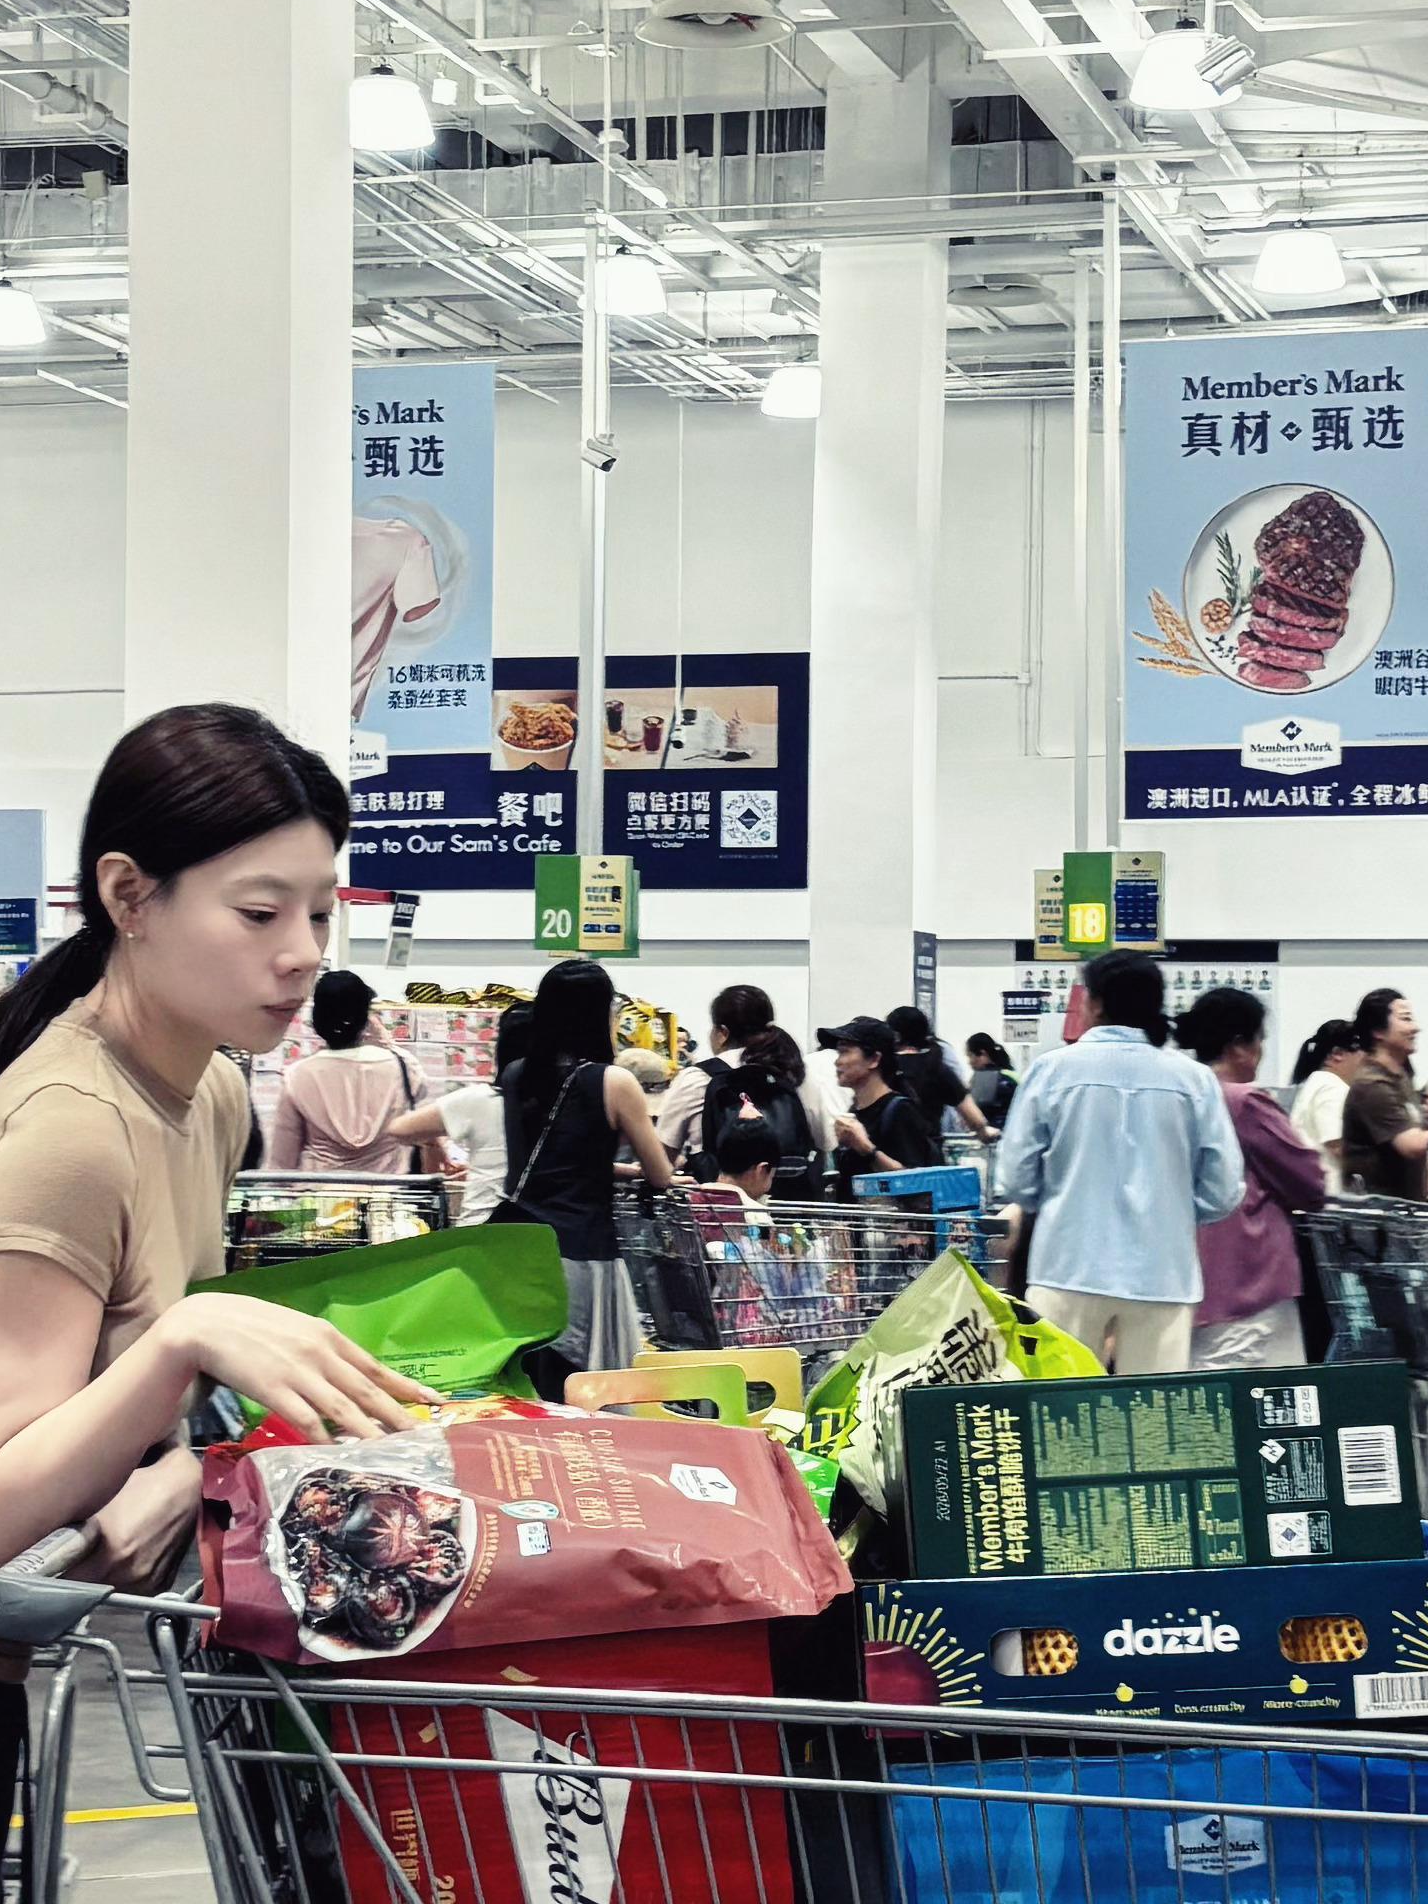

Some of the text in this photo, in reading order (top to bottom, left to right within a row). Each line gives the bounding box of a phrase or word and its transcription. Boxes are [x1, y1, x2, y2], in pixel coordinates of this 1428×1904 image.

[1182, 367, 1405, 402] Member's Mark
[374, 398, 445, 424] Mark
[1180, 405, 1406, 457] 真材 甄选
[363, 434, 446, 478] 甄选
[497, 792, 563, 827] 餐吧
[627, 791, 711, 813] 微信扫码
[383, 838, 403, 853] to
[407, 835, 444, 853] Our
[450, 834, 508, 853] Sam's
[513, 833, 562, 853] Cafe
[542, 909, 571, 938] 20
[1071, 908, 1102, 938] 18
[967, 1403, 1004, 1570] Member's Mark
[1103, 1616, 1240, 1657] dazzle
